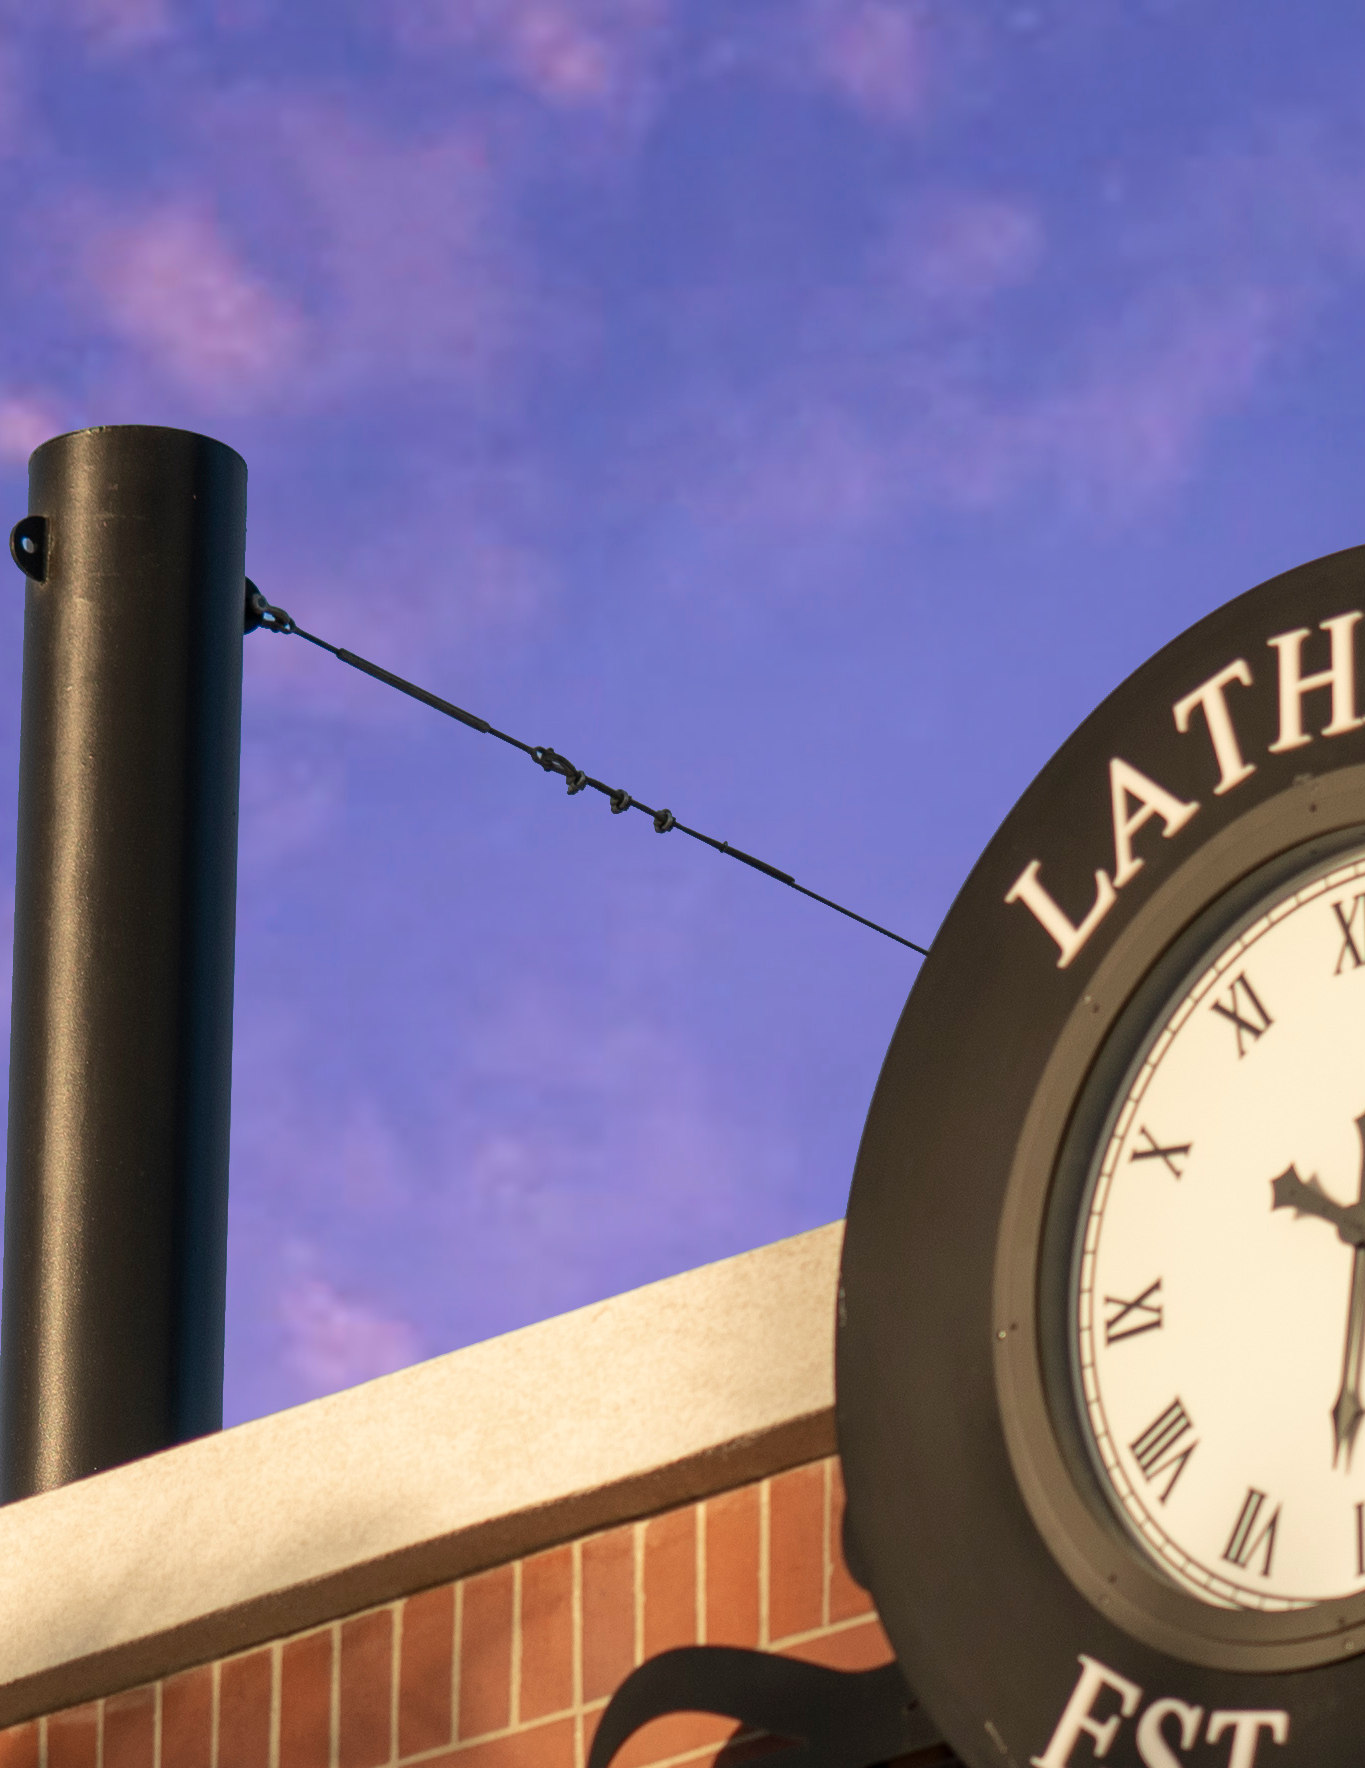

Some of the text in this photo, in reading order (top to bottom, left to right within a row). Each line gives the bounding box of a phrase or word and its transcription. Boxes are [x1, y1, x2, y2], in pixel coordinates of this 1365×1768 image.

[1210, 971, 1275, 1060] XI
[1129, 1125, 1193, 1180] X
[1104, 1278, 1164, 1347] IX
[1129, 1397, 1200, 1505] VIII
[1221, 1487, 1282, 1578] VII
